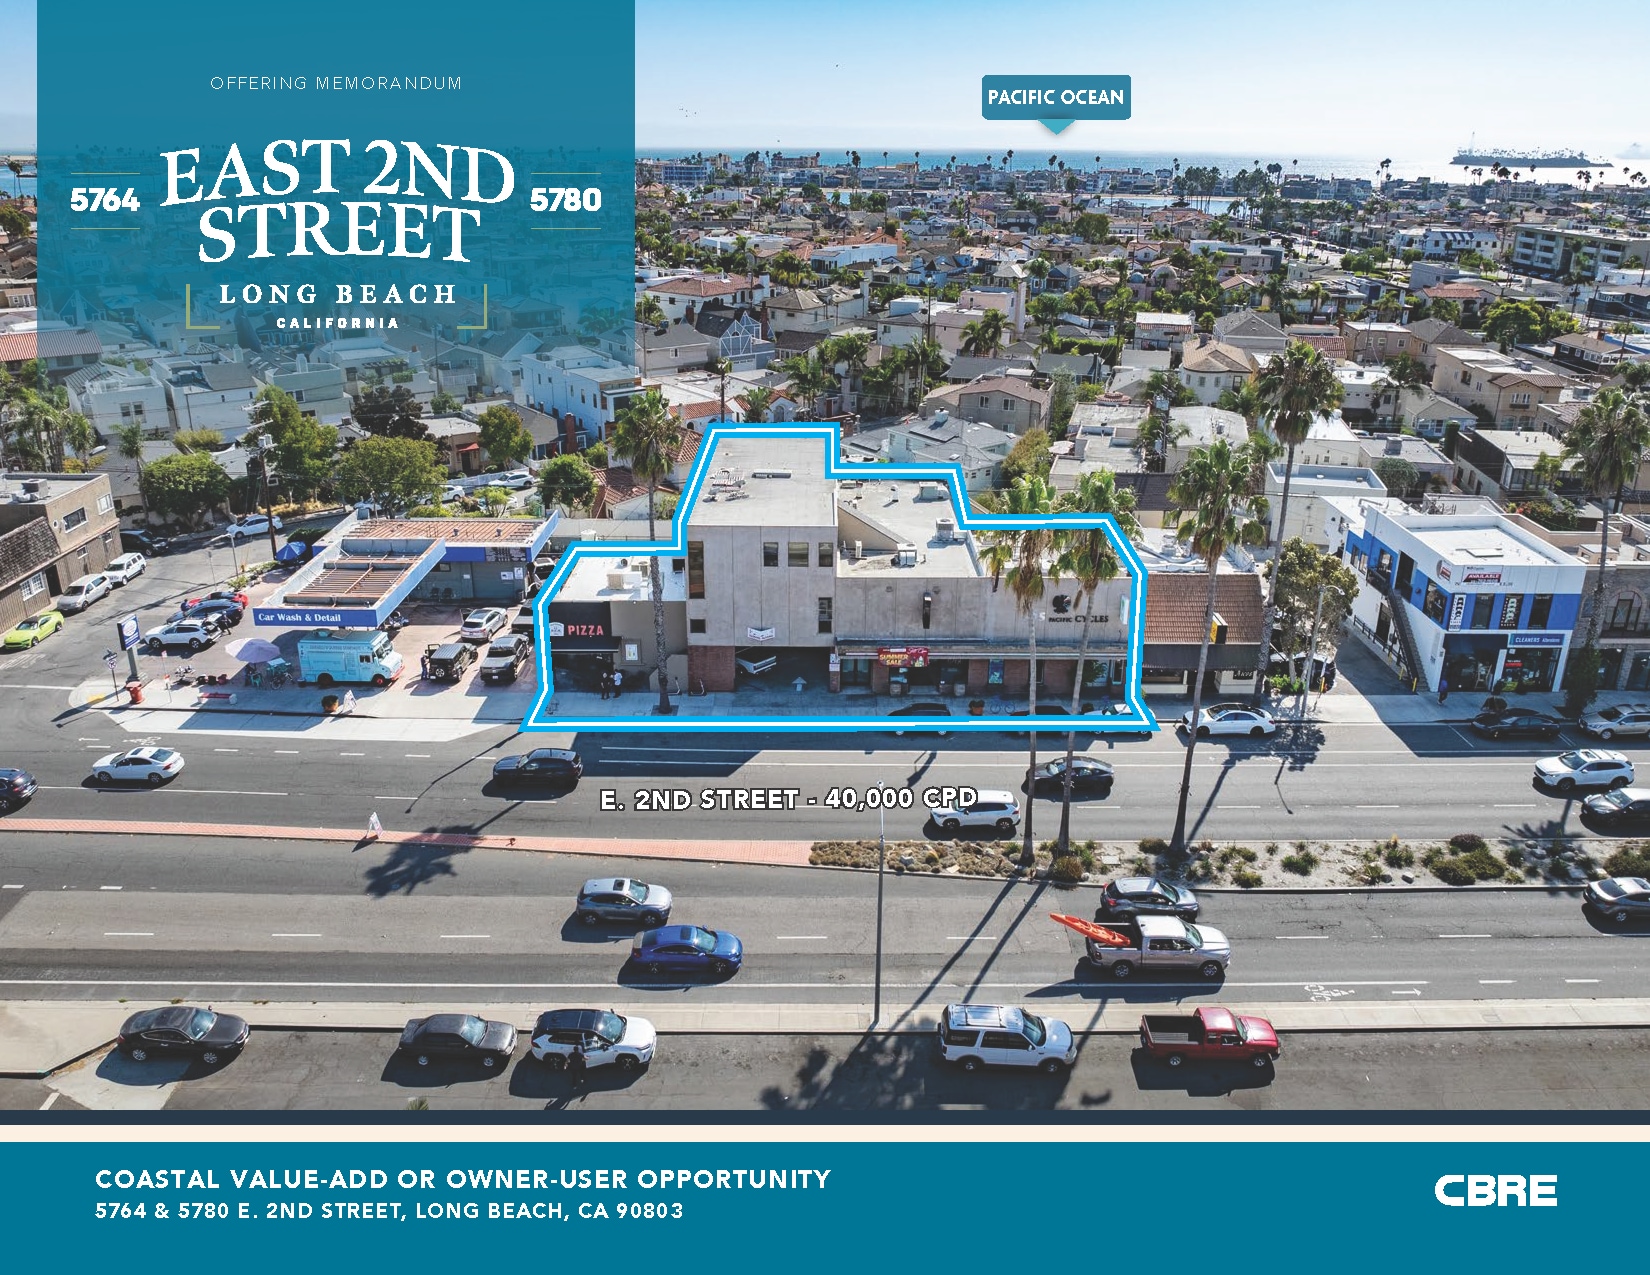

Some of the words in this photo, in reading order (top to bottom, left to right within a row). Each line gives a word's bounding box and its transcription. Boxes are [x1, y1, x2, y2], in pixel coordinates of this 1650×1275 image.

[258, 613, 275, 621] Car
[277, 613, 302, 621] Wash
[305, 613, 312, 622] &
[314, 613, 341, 622] Detail
[567, 624, 605, 636] PIZZA
[879, 653, 909, 661] SUMMER
